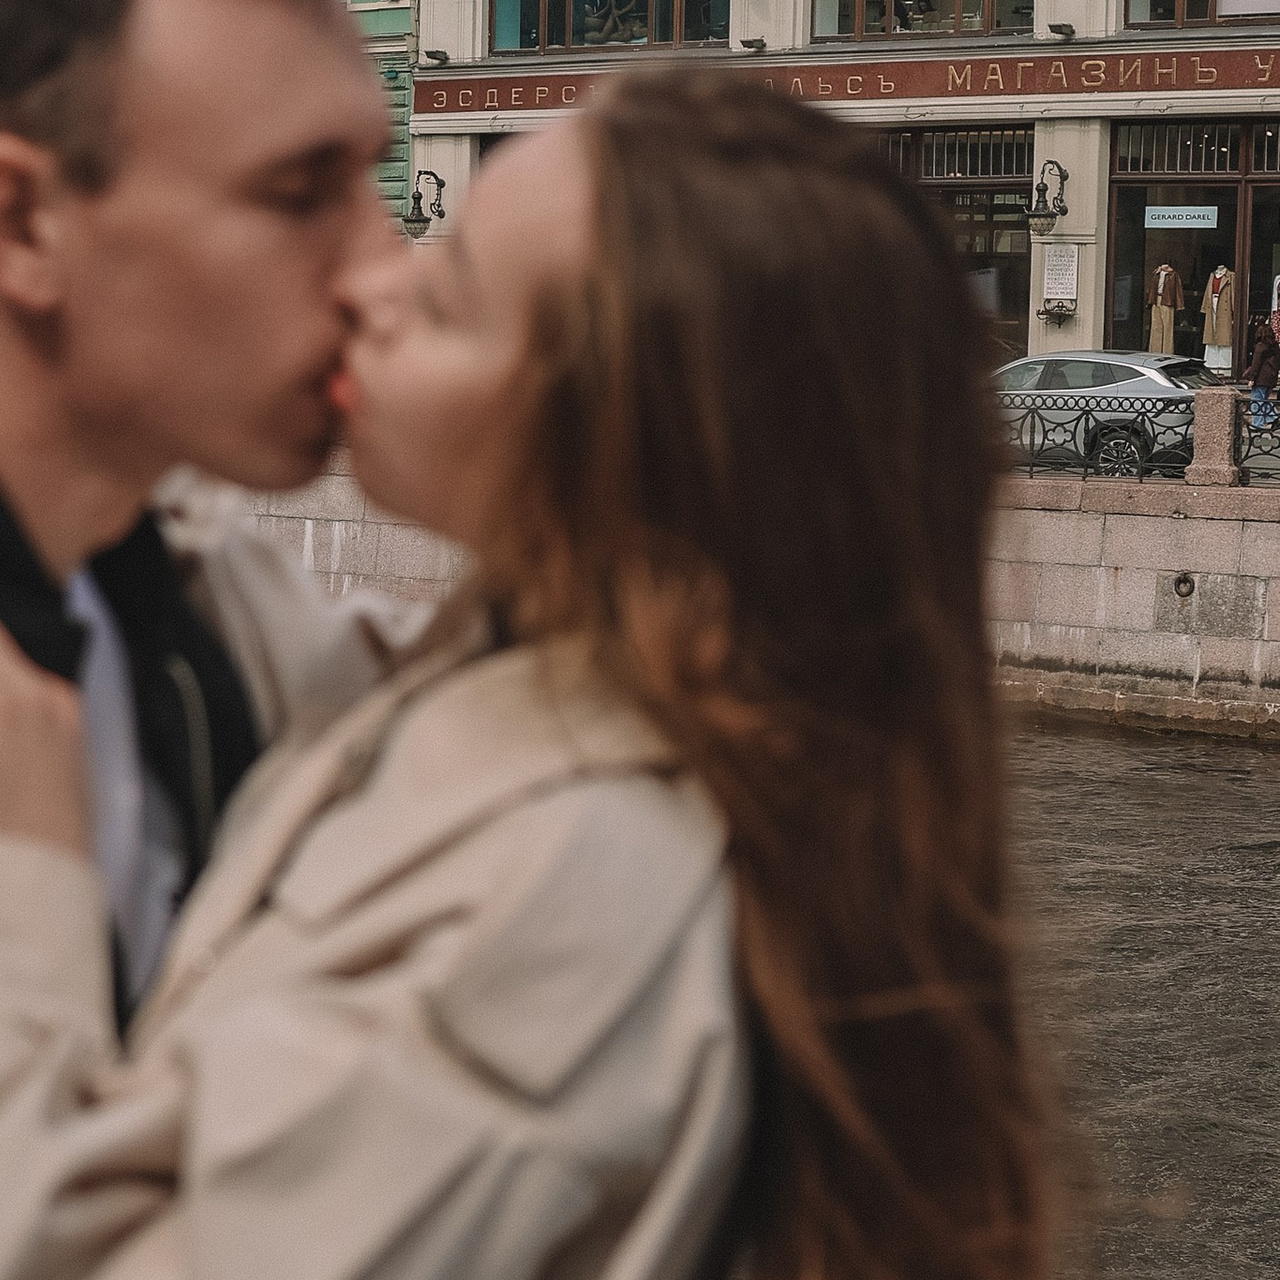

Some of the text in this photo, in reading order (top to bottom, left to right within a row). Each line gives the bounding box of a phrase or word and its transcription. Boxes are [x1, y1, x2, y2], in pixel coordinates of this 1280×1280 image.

[433, 85, 598, 109] ЭСДЕРС
[947, 56, 1218, 91] МАГАЗИНЪ
[1150, 213, 1212, 221] GERARD DAREL
